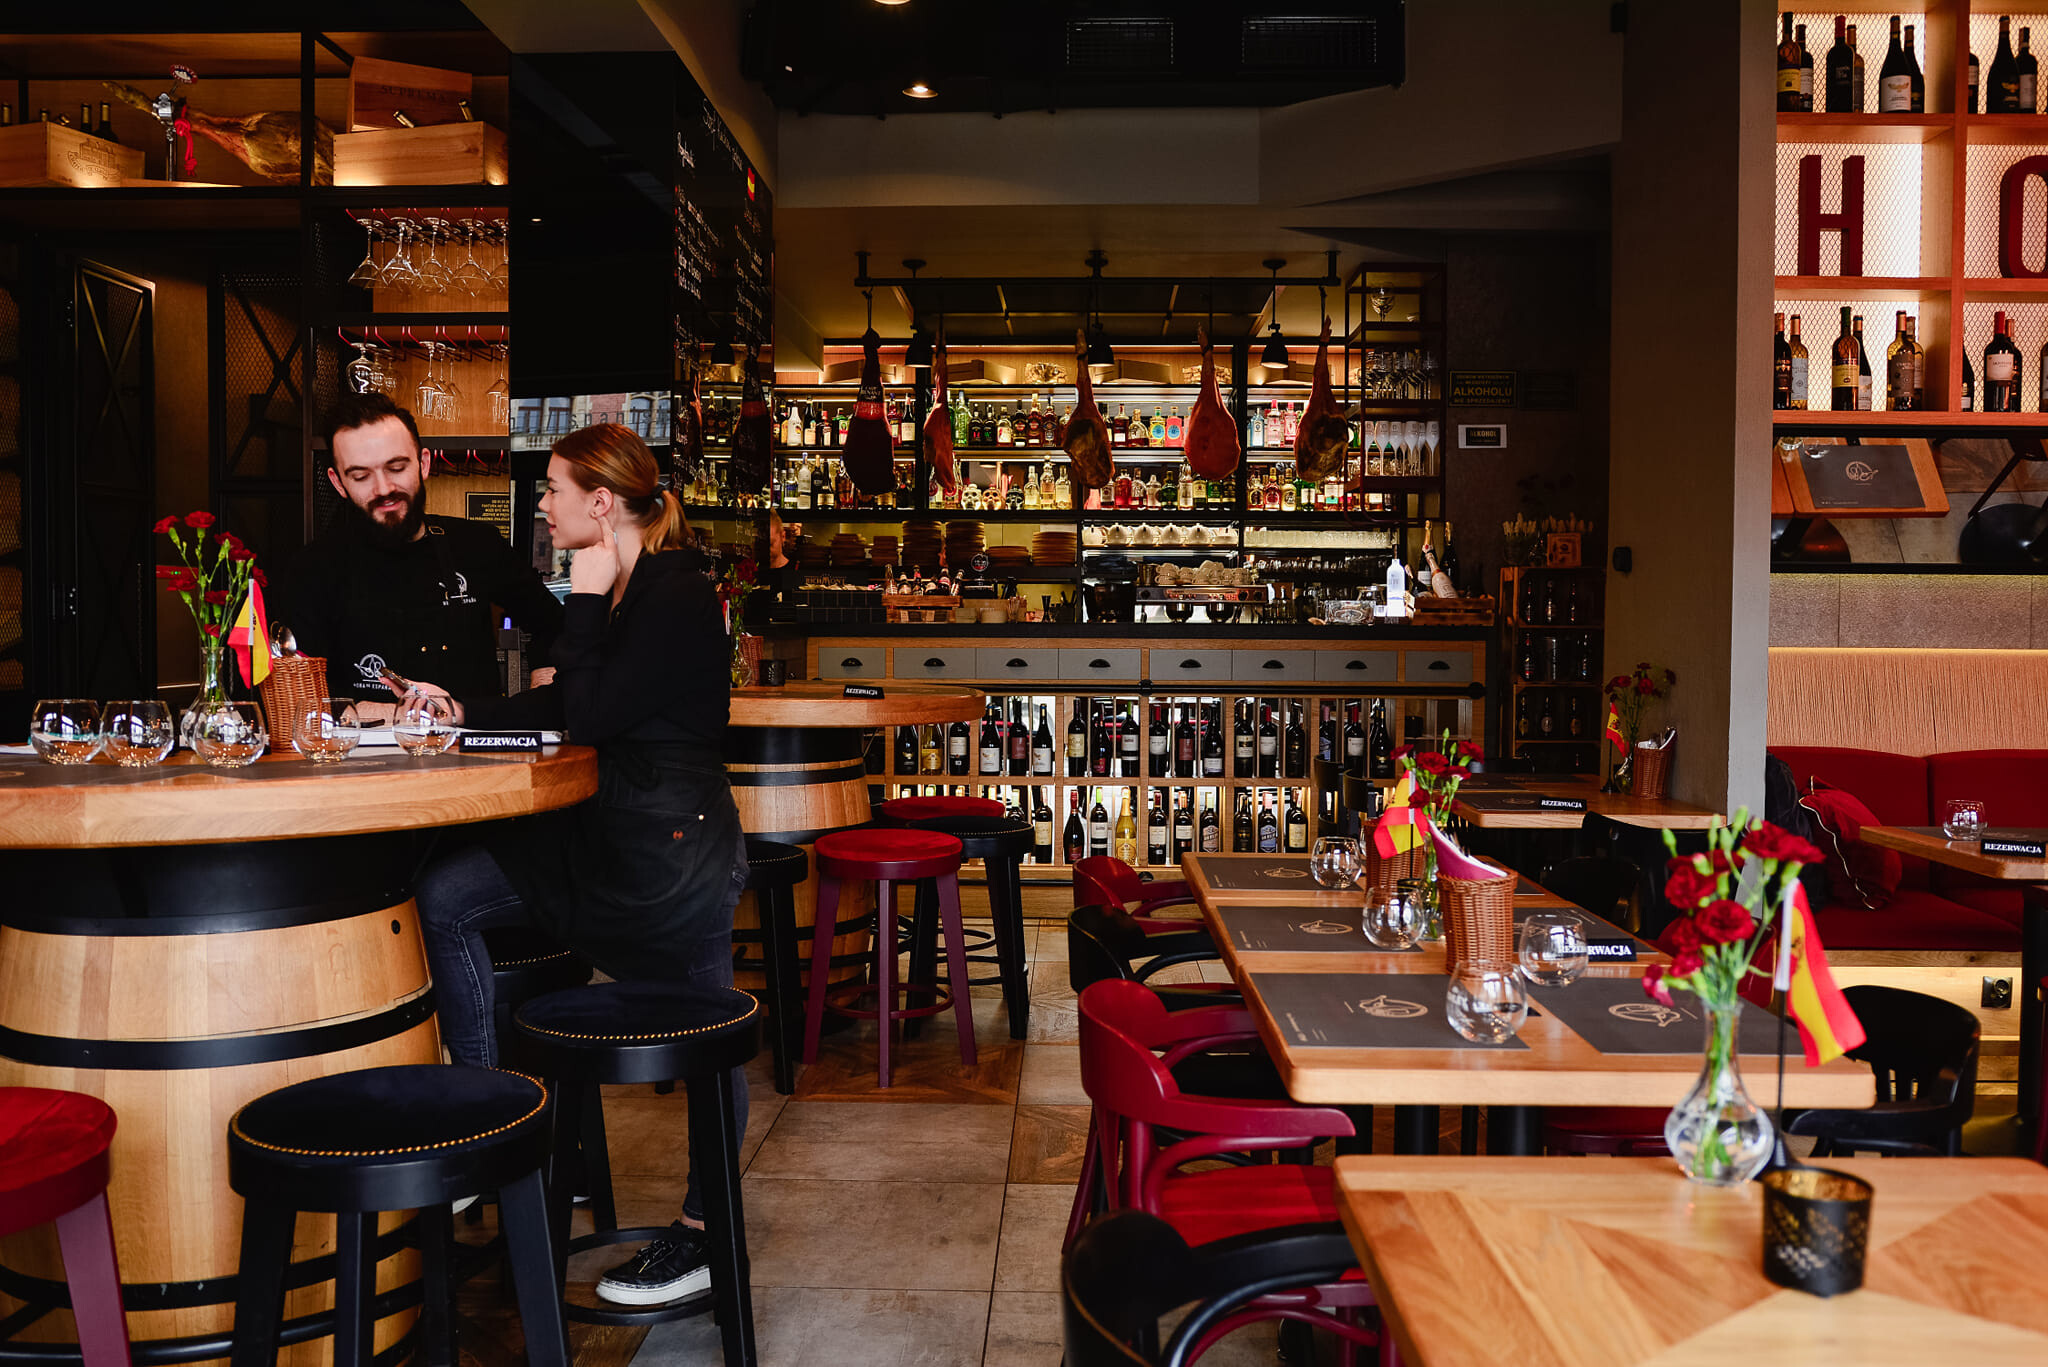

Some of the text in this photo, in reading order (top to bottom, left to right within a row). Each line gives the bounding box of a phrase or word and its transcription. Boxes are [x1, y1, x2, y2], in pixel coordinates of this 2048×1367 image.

[1453, 386, 1513, 397] ALKOHOLU
[463, 736, 538, 747] REZERWACJA
[1541, 799, 1583, 809] REZERWACJA
[1984, 842, 2042, 853] REZERWACJA
